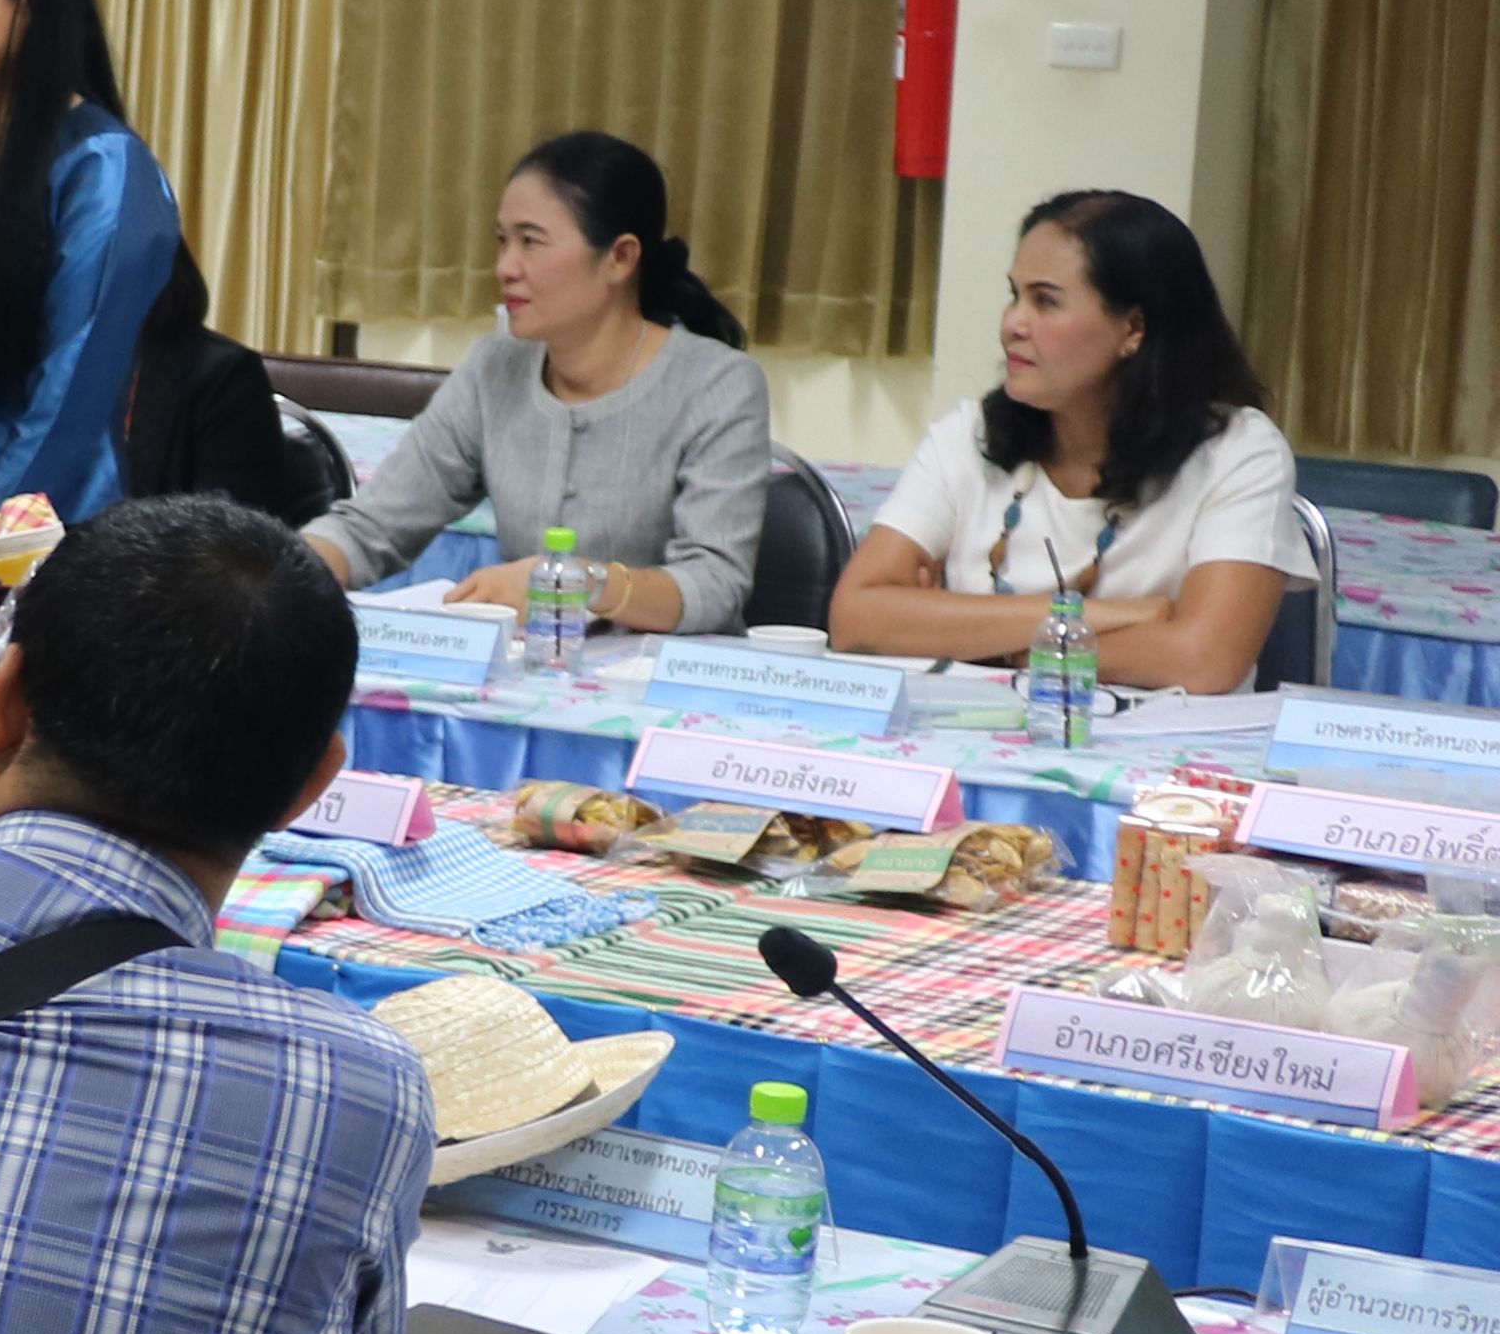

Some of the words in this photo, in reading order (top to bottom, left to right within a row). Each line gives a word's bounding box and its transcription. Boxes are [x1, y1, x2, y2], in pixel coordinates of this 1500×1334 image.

[711, 753, 858, 799] อำเภอสังคม
[1054, 1013, 1339, 1093] อำเภอศรีเชียงใหม่
[533, 1198, 625, 1233] กรรมการ
